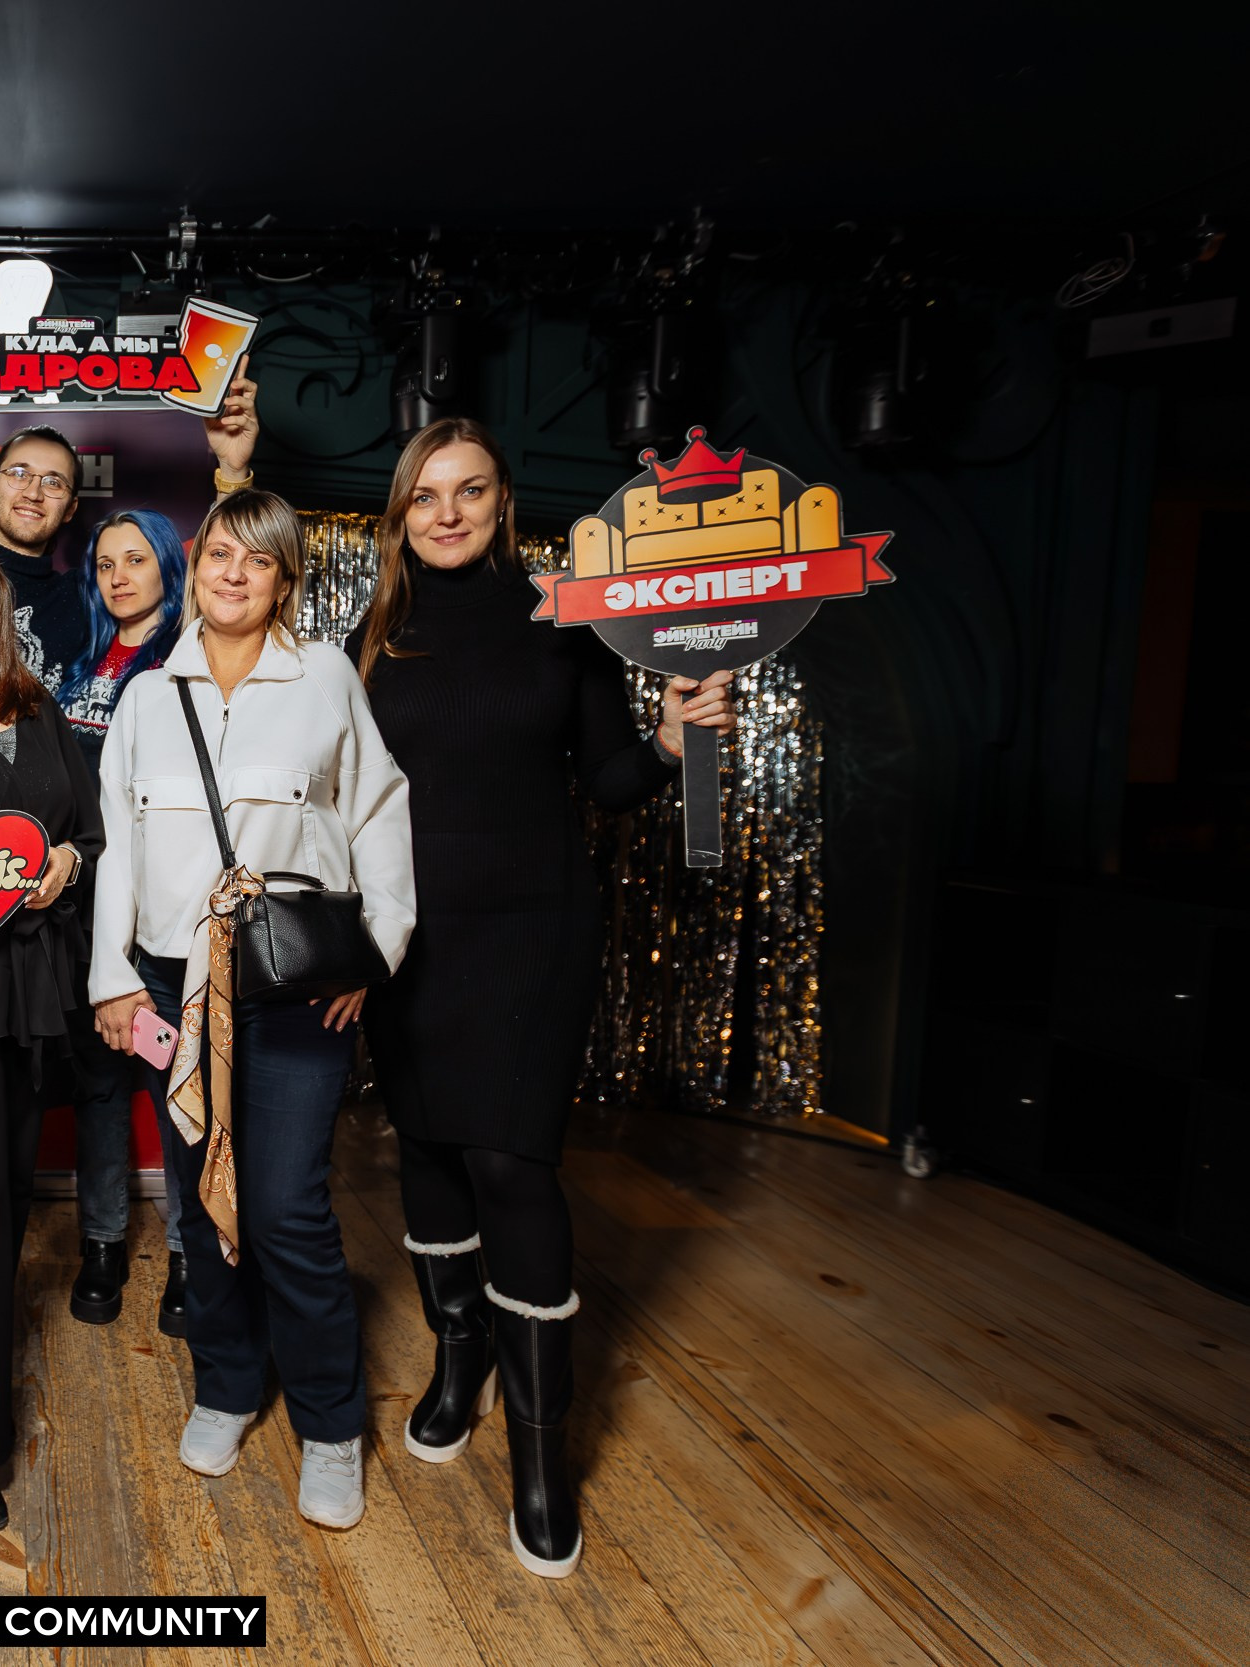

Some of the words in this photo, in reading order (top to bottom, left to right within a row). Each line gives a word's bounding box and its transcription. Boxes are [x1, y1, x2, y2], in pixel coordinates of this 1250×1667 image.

[5, 336, 83, 353] КУДА,
[88, 336, 110, 352] А
[113, 337, 158, 353] МЫ
[604, 561, 808, 611] ЭКСПЕРТ
[653, 620, 758, 643] ЭЙНШТЕЙН
[683, 637, 724, 651] Party
